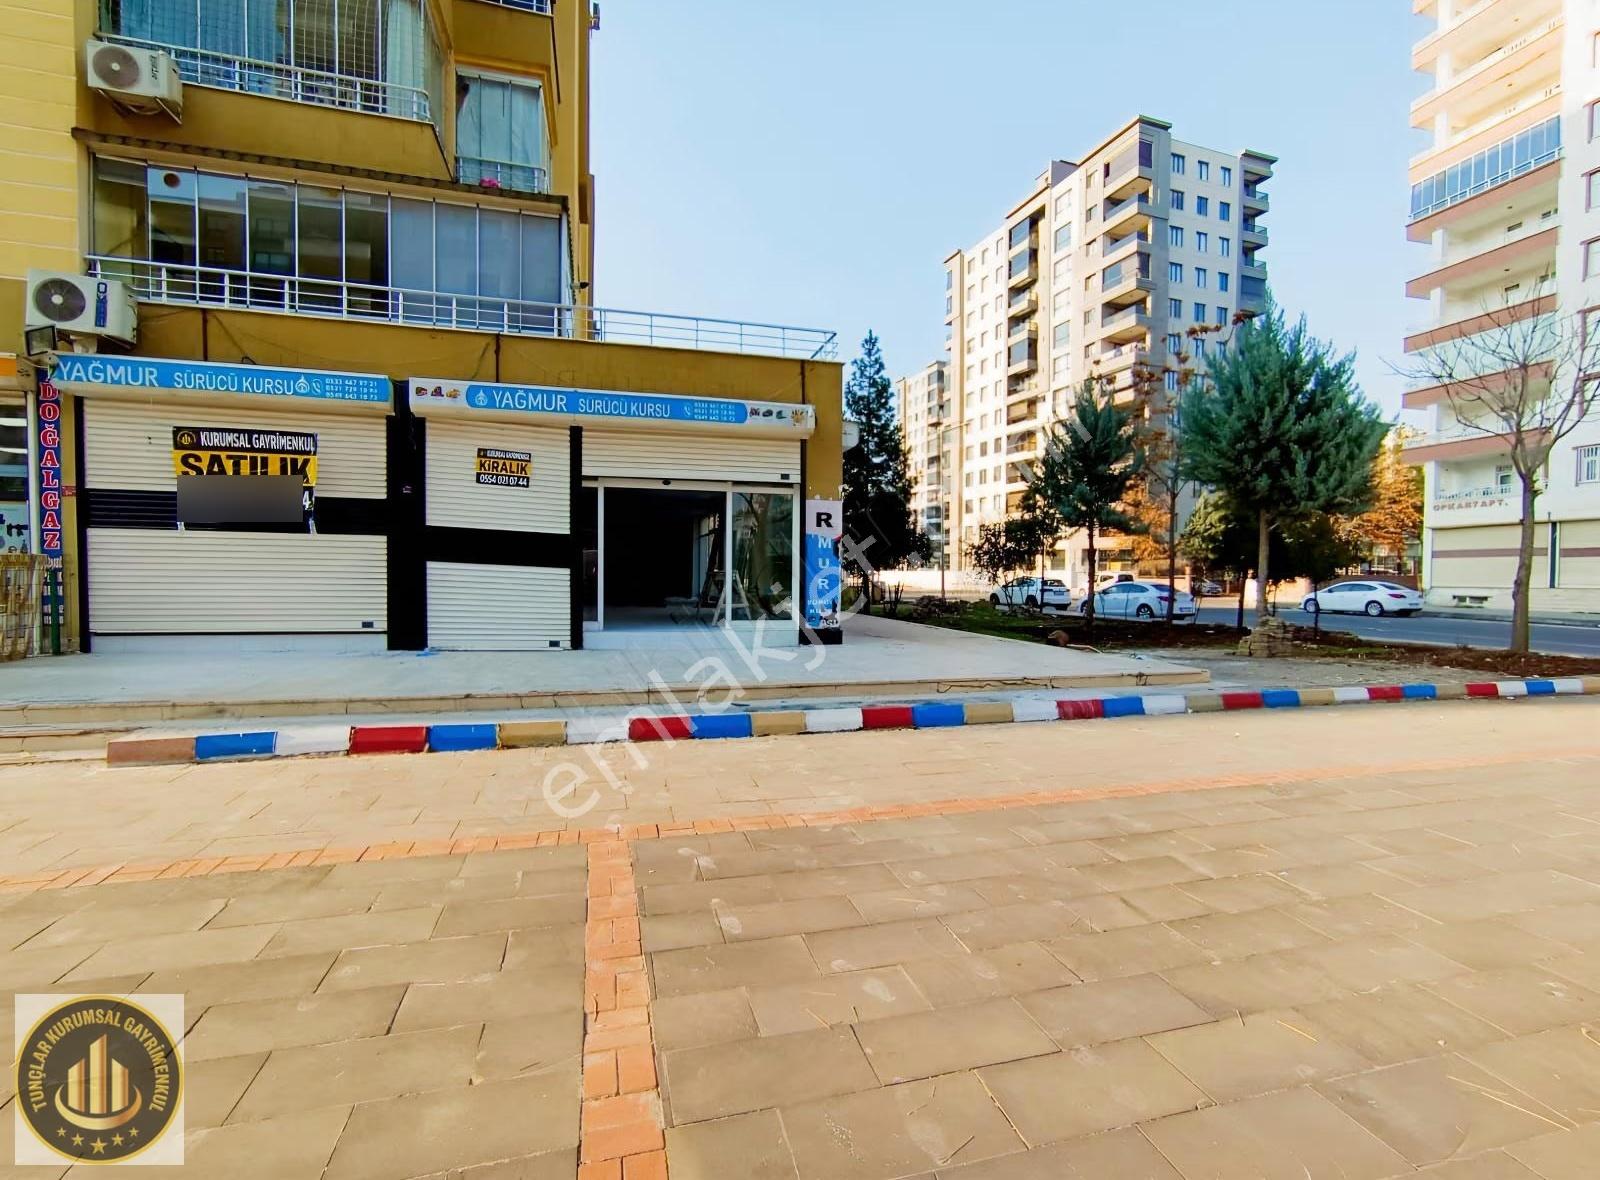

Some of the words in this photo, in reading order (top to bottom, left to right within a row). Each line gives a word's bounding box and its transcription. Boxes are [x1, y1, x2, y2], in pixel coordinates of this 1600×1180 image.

[57, 360, 159, 387] YAĞMUR
[174, 371, 237, 392] SÜRÜCÜ
[243, 377, 293, 395] KURSU
[493, 389, 567, 412] YAĞMUR
[578, 397, 627, 417] SÜRÜCÜ
[630, 399, 670, 418] KURSU
[200, 431, 251, 448] KURUMSAL
[252, 433, 315, 452] GAYRİMENKUL
[40, 383, 60, 549] DOĞALGAZ
[479, 459, 528, 475] KIRALIK
